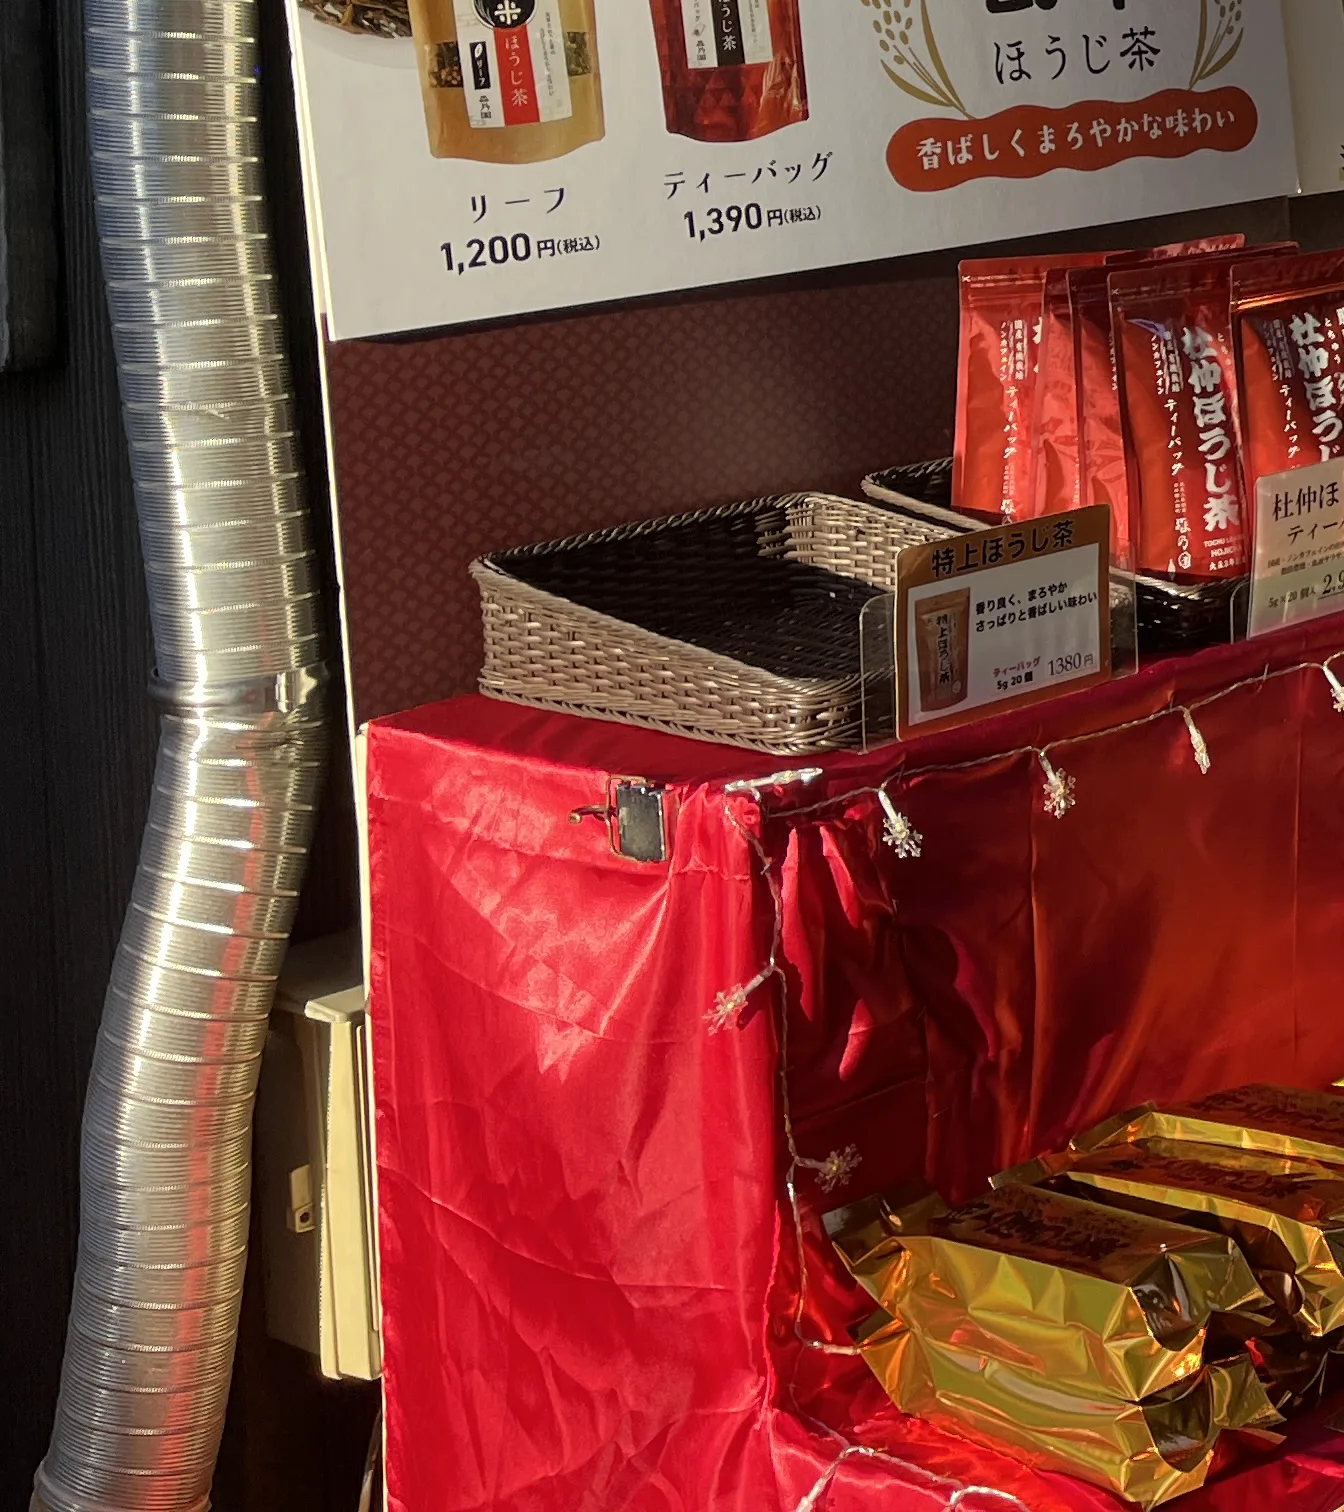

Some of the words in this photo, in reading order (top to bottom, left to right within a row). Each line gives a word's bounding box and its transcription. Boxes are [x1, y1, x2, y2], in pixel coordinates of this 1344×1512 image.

[505, 35, 529, 107] ほうじ茶
[994, 26, 1163, 85] ほうじ茶
[916, 104, 1237, 172] 香ばしくまろやかな味わい
[663, 149, 834, 202] ティーバッグ
[466, 185, 569, 223] リーフ
[682, 200, 823, 242] 1,390円(税込)
[439, 231, 602, 274] 1,200円(税込)
[1164, 398, 1185, 477] ティーバッグ
[1181, 326, 1242, 533] 杜仲ほうじ茶
[931, 519, 1075, 578] 特上ほうじ茶
[975, 591, 1099, 633] さっぱりと香ばしい味わい
[1047, 652, 1095, 677] 1380円
